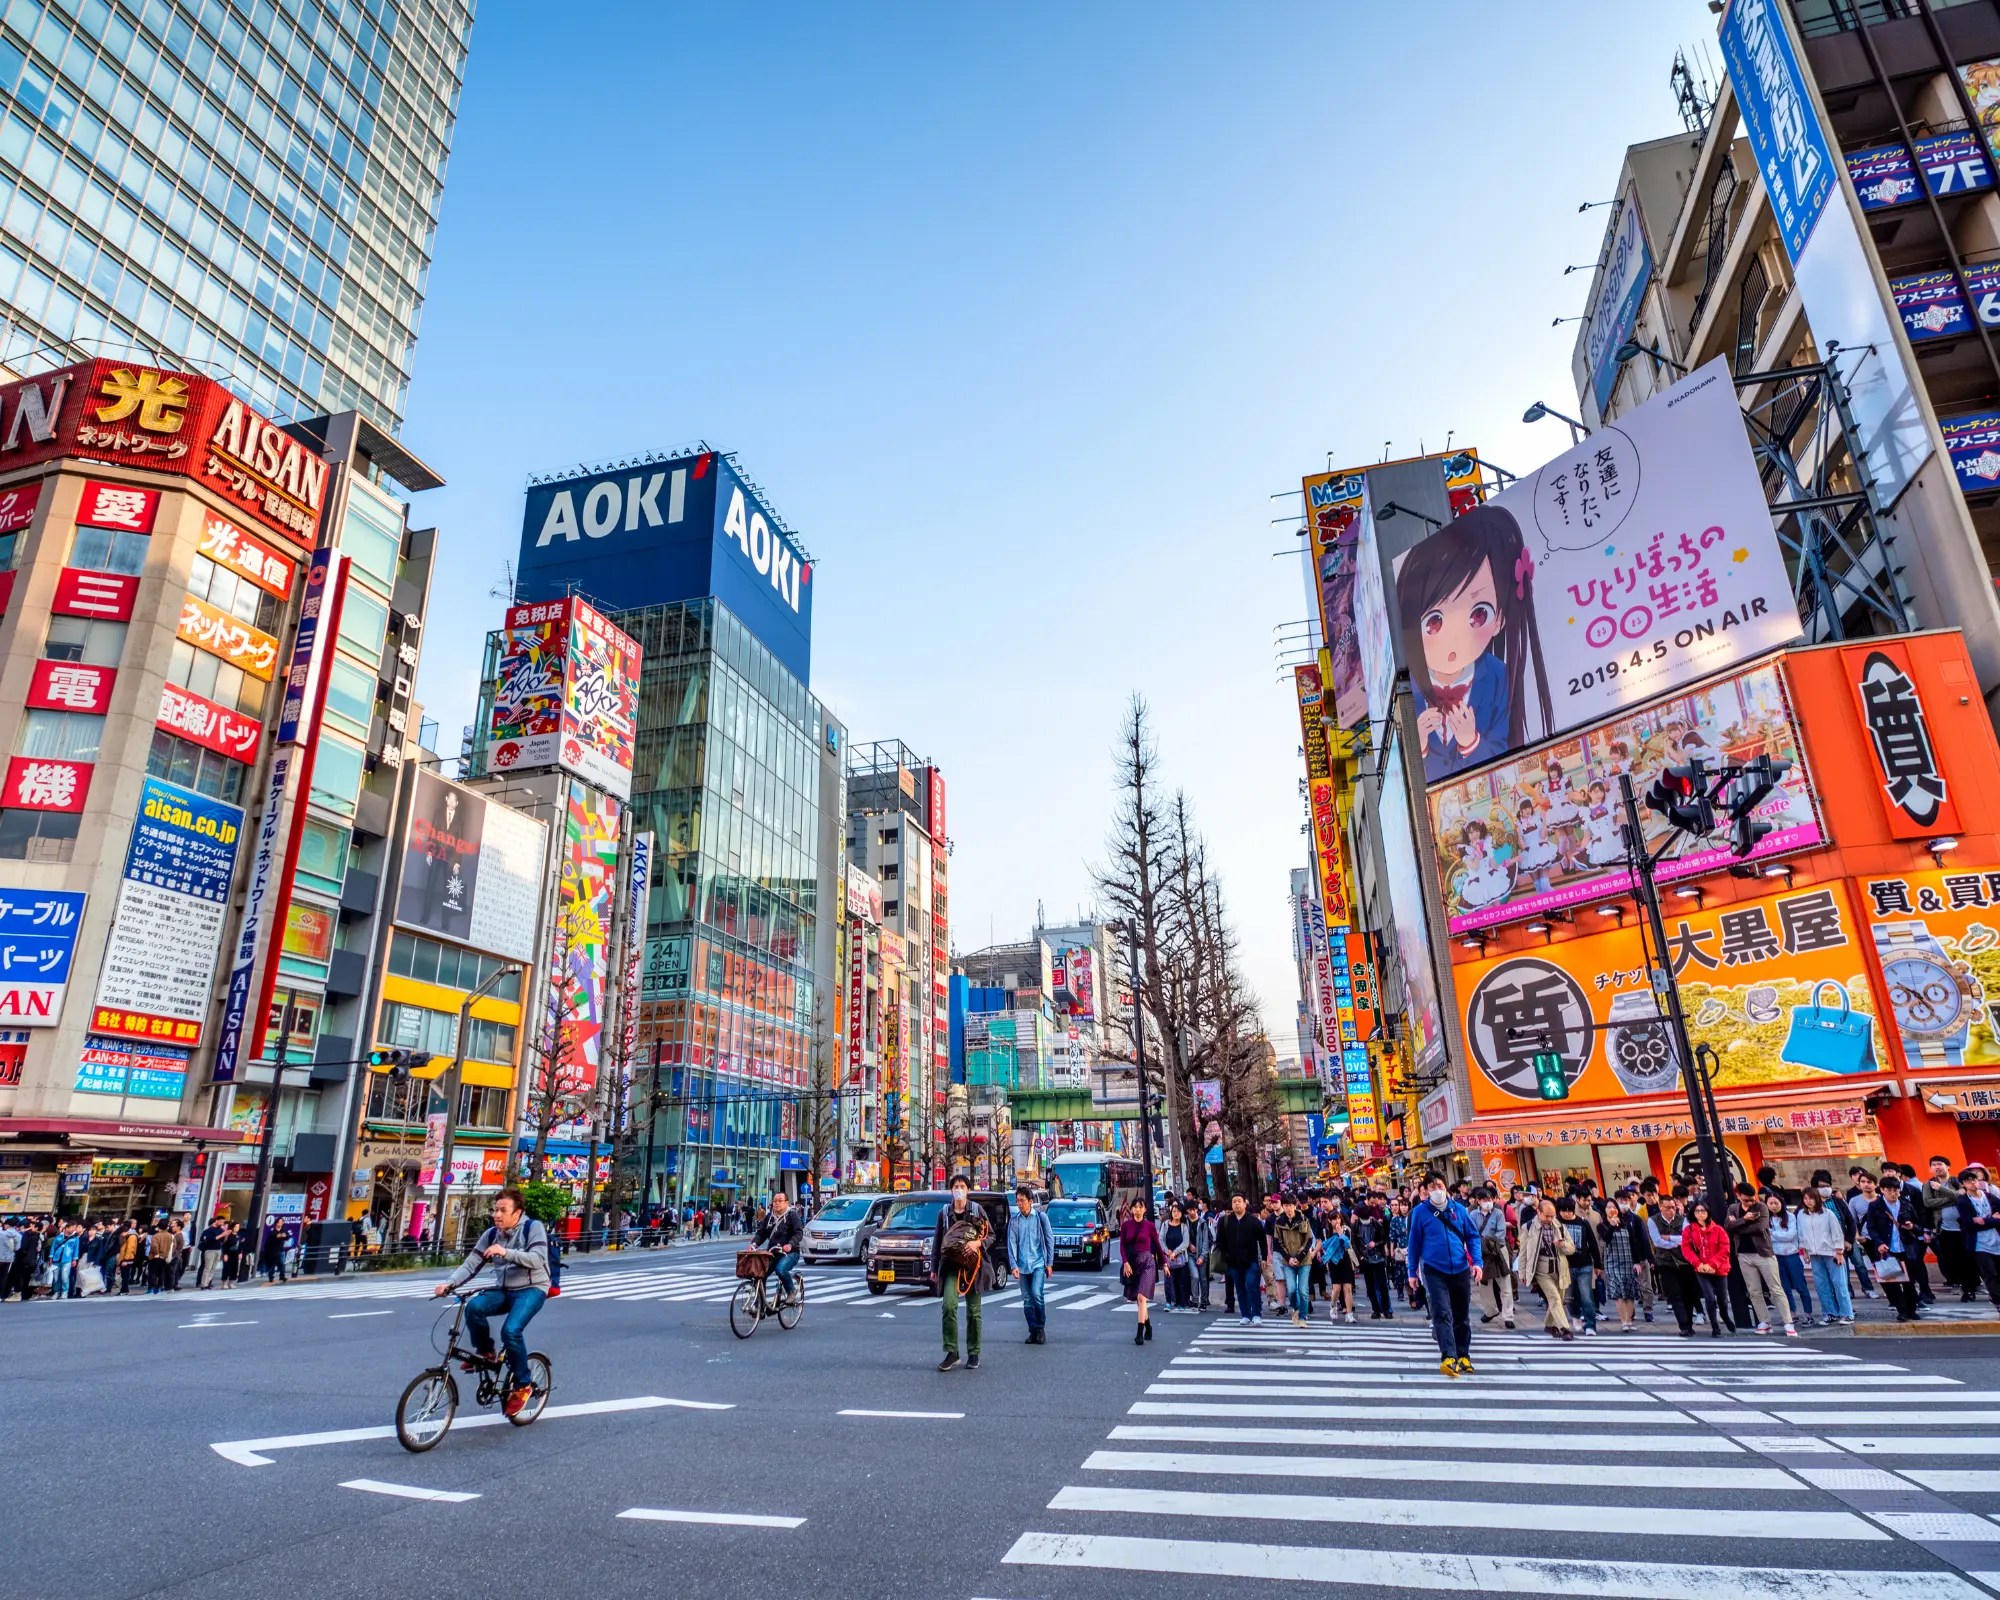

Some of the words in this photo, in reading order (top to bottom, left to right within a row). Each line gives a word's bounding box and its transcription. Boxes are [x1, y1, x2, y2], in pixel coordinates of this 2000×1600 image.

[1927, 158, 1987, 194] 7F
[96, 368, 189, 433] 光
[1674, 375, 1718, 405] KADOKAWA
[77, 426, 187, 459] ネットワーク
[213, 400, 327, 511] AISAN
[1573, 462, 1601, 528] なりたい
[1594, 445, 1622, 502] 友達に
[92, 488, 146, 527] 愛
[536, 468, 687, 548] AOKI
[200, 520, 289, 591] 光通信
[724, 486, 800, 615] AOKI
[1568, 525, 1726, 610] ひとりぼっちの
[180, 602, 275, 669] ネットワーク
[514, 603, 563, 626] 免税店
[283, 595, 320, 724] 愛三電機
[1568, 640, 1667, 696] 2019.4.5
[1675, 618, 1715, 648] ON
[1721, 597, 1768, 633] AIR
[47, 667, 101, 708] 電
[157, 691, 258, 752] 配線パーツ
[1305, 721, 1323, 729] ゲーム
[1306, 738, 1325, 746] アイドル
[1860, 672, 1948, 808] 質
[18, 763, 77, 807] 機
[934, 778, 944, 837] カラオケ
[1759, 799, 1791, 817] cafe
[143, 797, 237, 845] aisan.co.jp
[633, 838, 648, 891] AKKY
[1311, 902, 1326, 939] AKKY
[1869, 880, 1914, 915] 質
[1920, 888, 1945, 912] &
[651, 942, 680, 959] 24h
[1667, 889, 1848, 973] 大黒屋
[650, 960, 679, 970] OPEN
[1317, 955, 1332, 1015] Tax-free
[1352, 961, 1371, 1011] 吉野家
[219, 973, 247, 1070] AISAN
[1324, 1016, 1337, 1053] Shop
[1480, 972, 1586, 1085] 質
[1346, 1062, 1368, 1071] DVD
[1353, 1117, 1374, 1125] AKIBA
[1455, 1133, 1500, 1148] 高価買取
[1790, 1107, 1863, 1128] 無料査定
